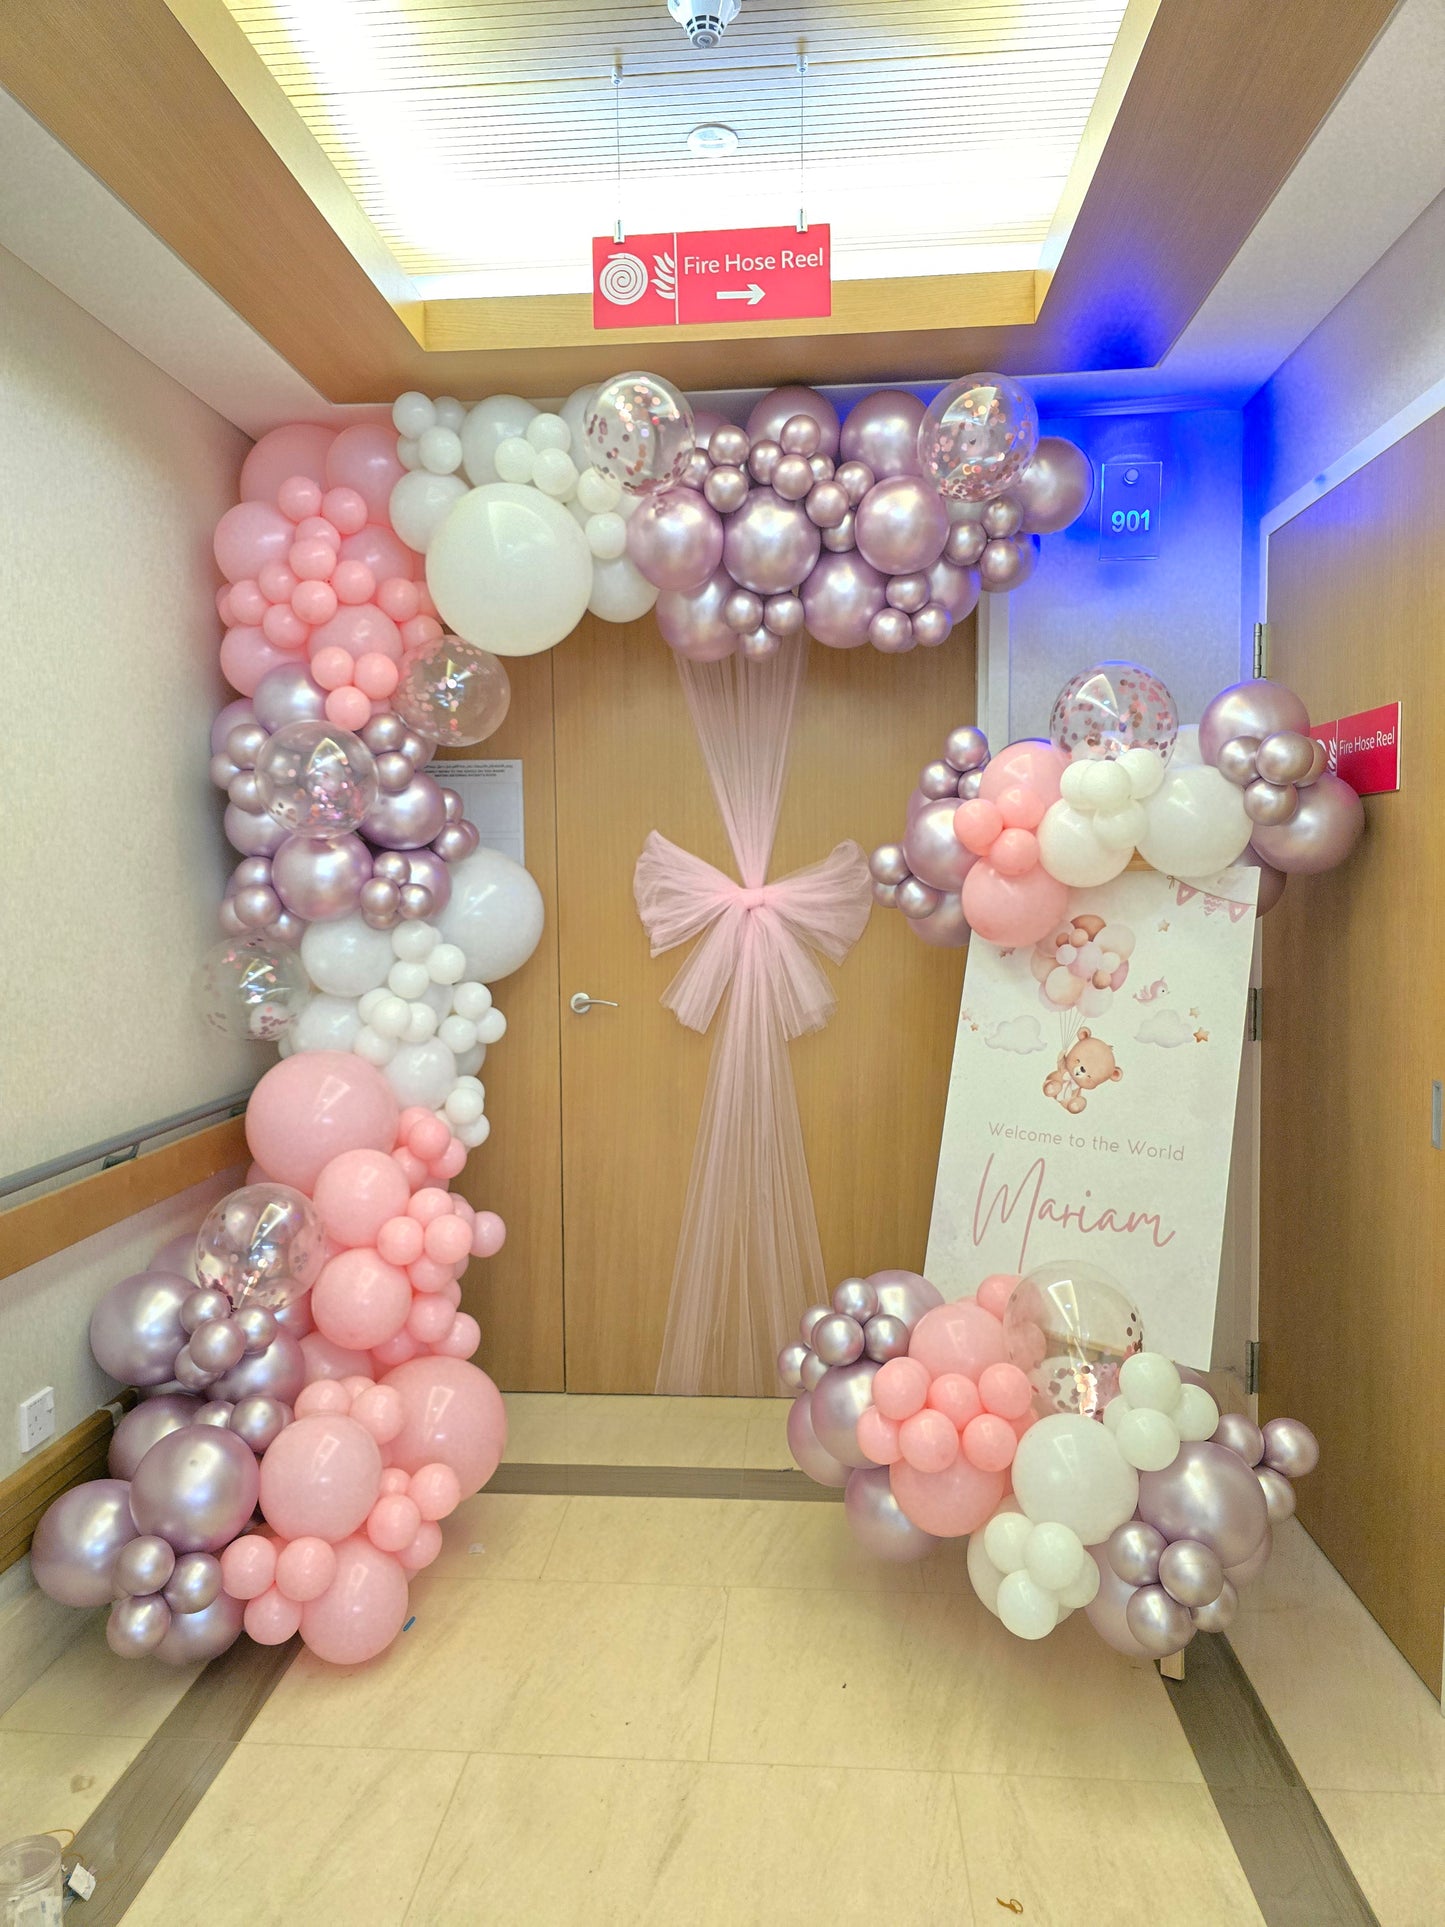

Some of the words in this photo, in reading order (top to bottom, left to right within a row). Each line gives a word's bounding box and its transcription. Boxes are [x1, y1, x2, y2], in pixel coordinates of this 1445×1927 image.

[684, 256, 720, 275] Fire
[725, 253, 776, 272] Hose
[781, 248, 824, 269] Reel
[1111, 509, 1150, 533] 901
[1339, 740, 1353, 756] Fire
[1354, 736, 1375, 752] Hose
[1376, 726, 1395, 747] Reel
[988, 1121, 1063, 1145] Welcome
[1069, 1133, 1086, 1148] to
[1092, 1136, 1119, 1153] the
[1128, 1139, 1185, 1161] World
[973, 1152, 1176, 1274] Mariam
